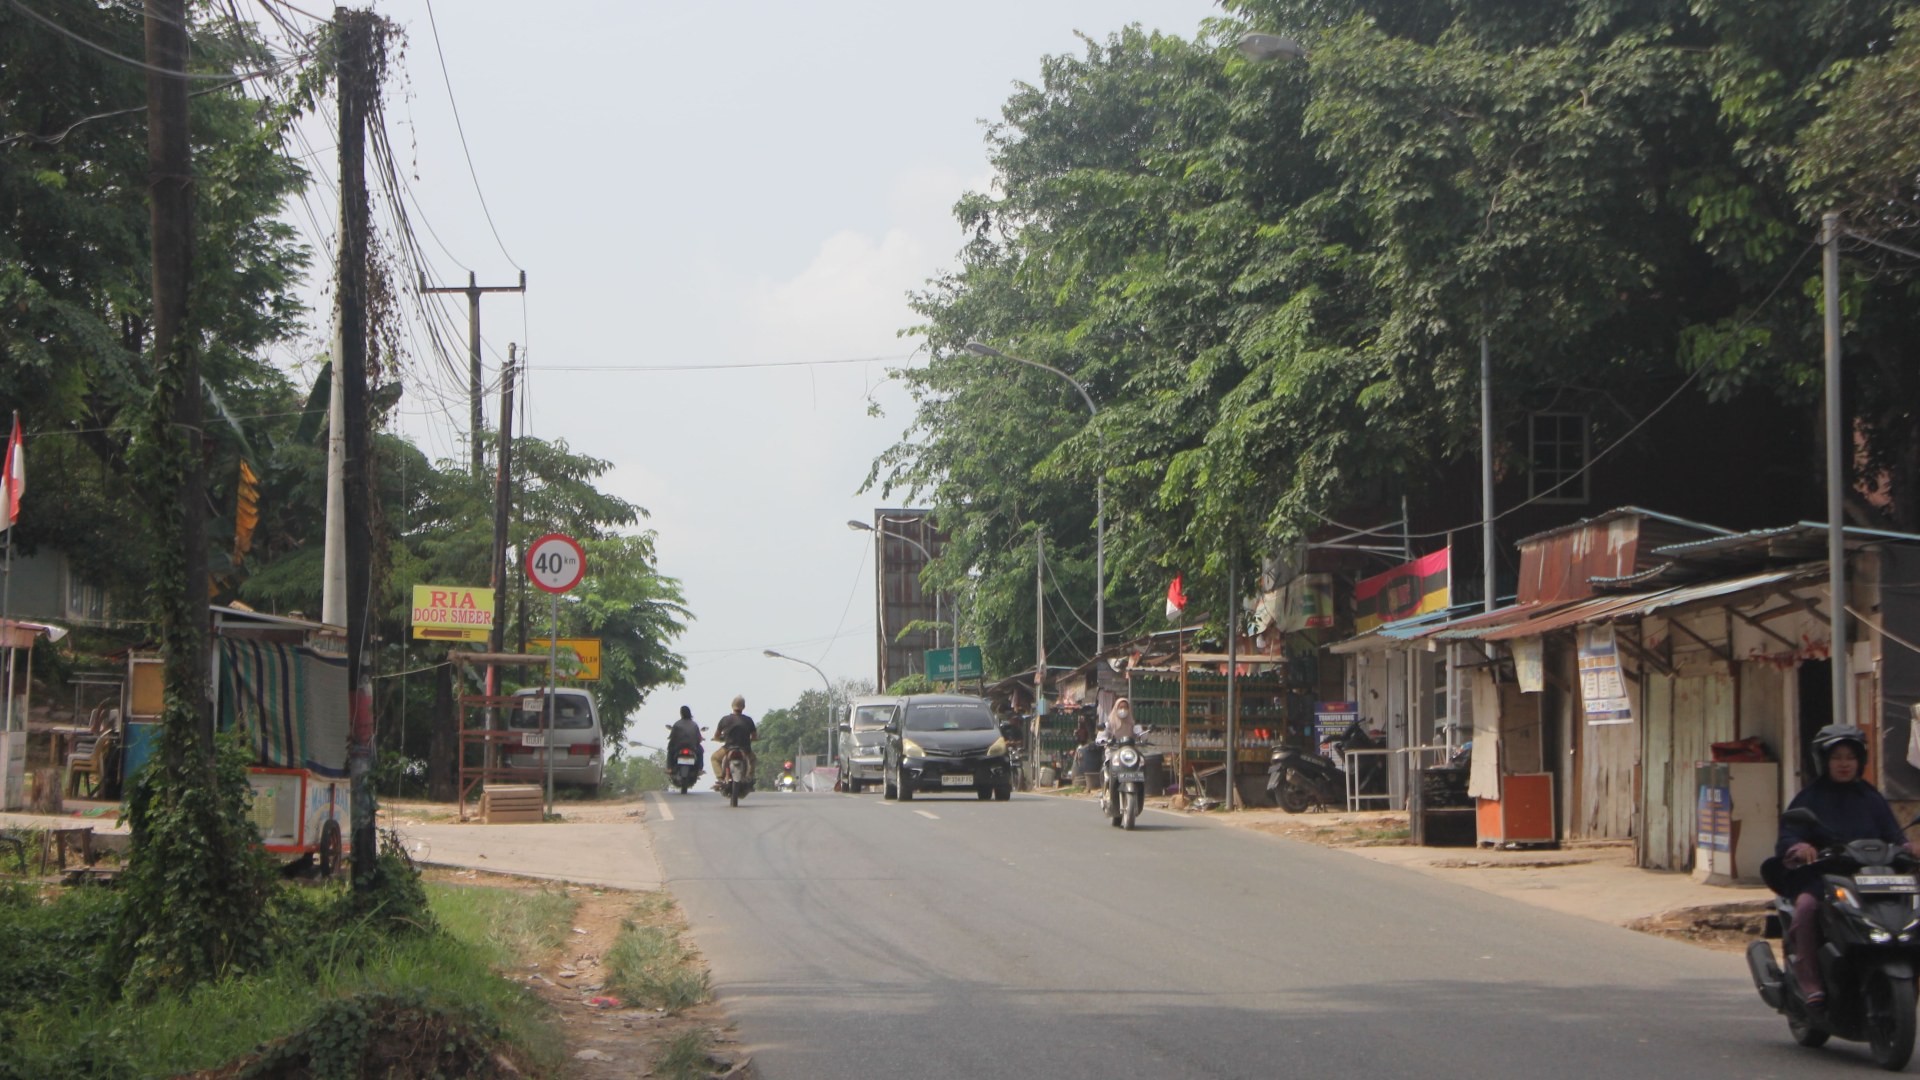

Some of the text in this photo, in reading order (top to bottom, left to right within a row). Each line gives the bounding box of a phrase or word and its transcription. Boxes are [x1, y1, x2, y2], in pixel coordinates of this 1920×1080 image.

[534, 553, 576, 574] 40 km
[430, 591, 476, 609] RIA
[414, 608, 492, 625] DOOR SMEER
[938, 662, 973, 673] Heinken
